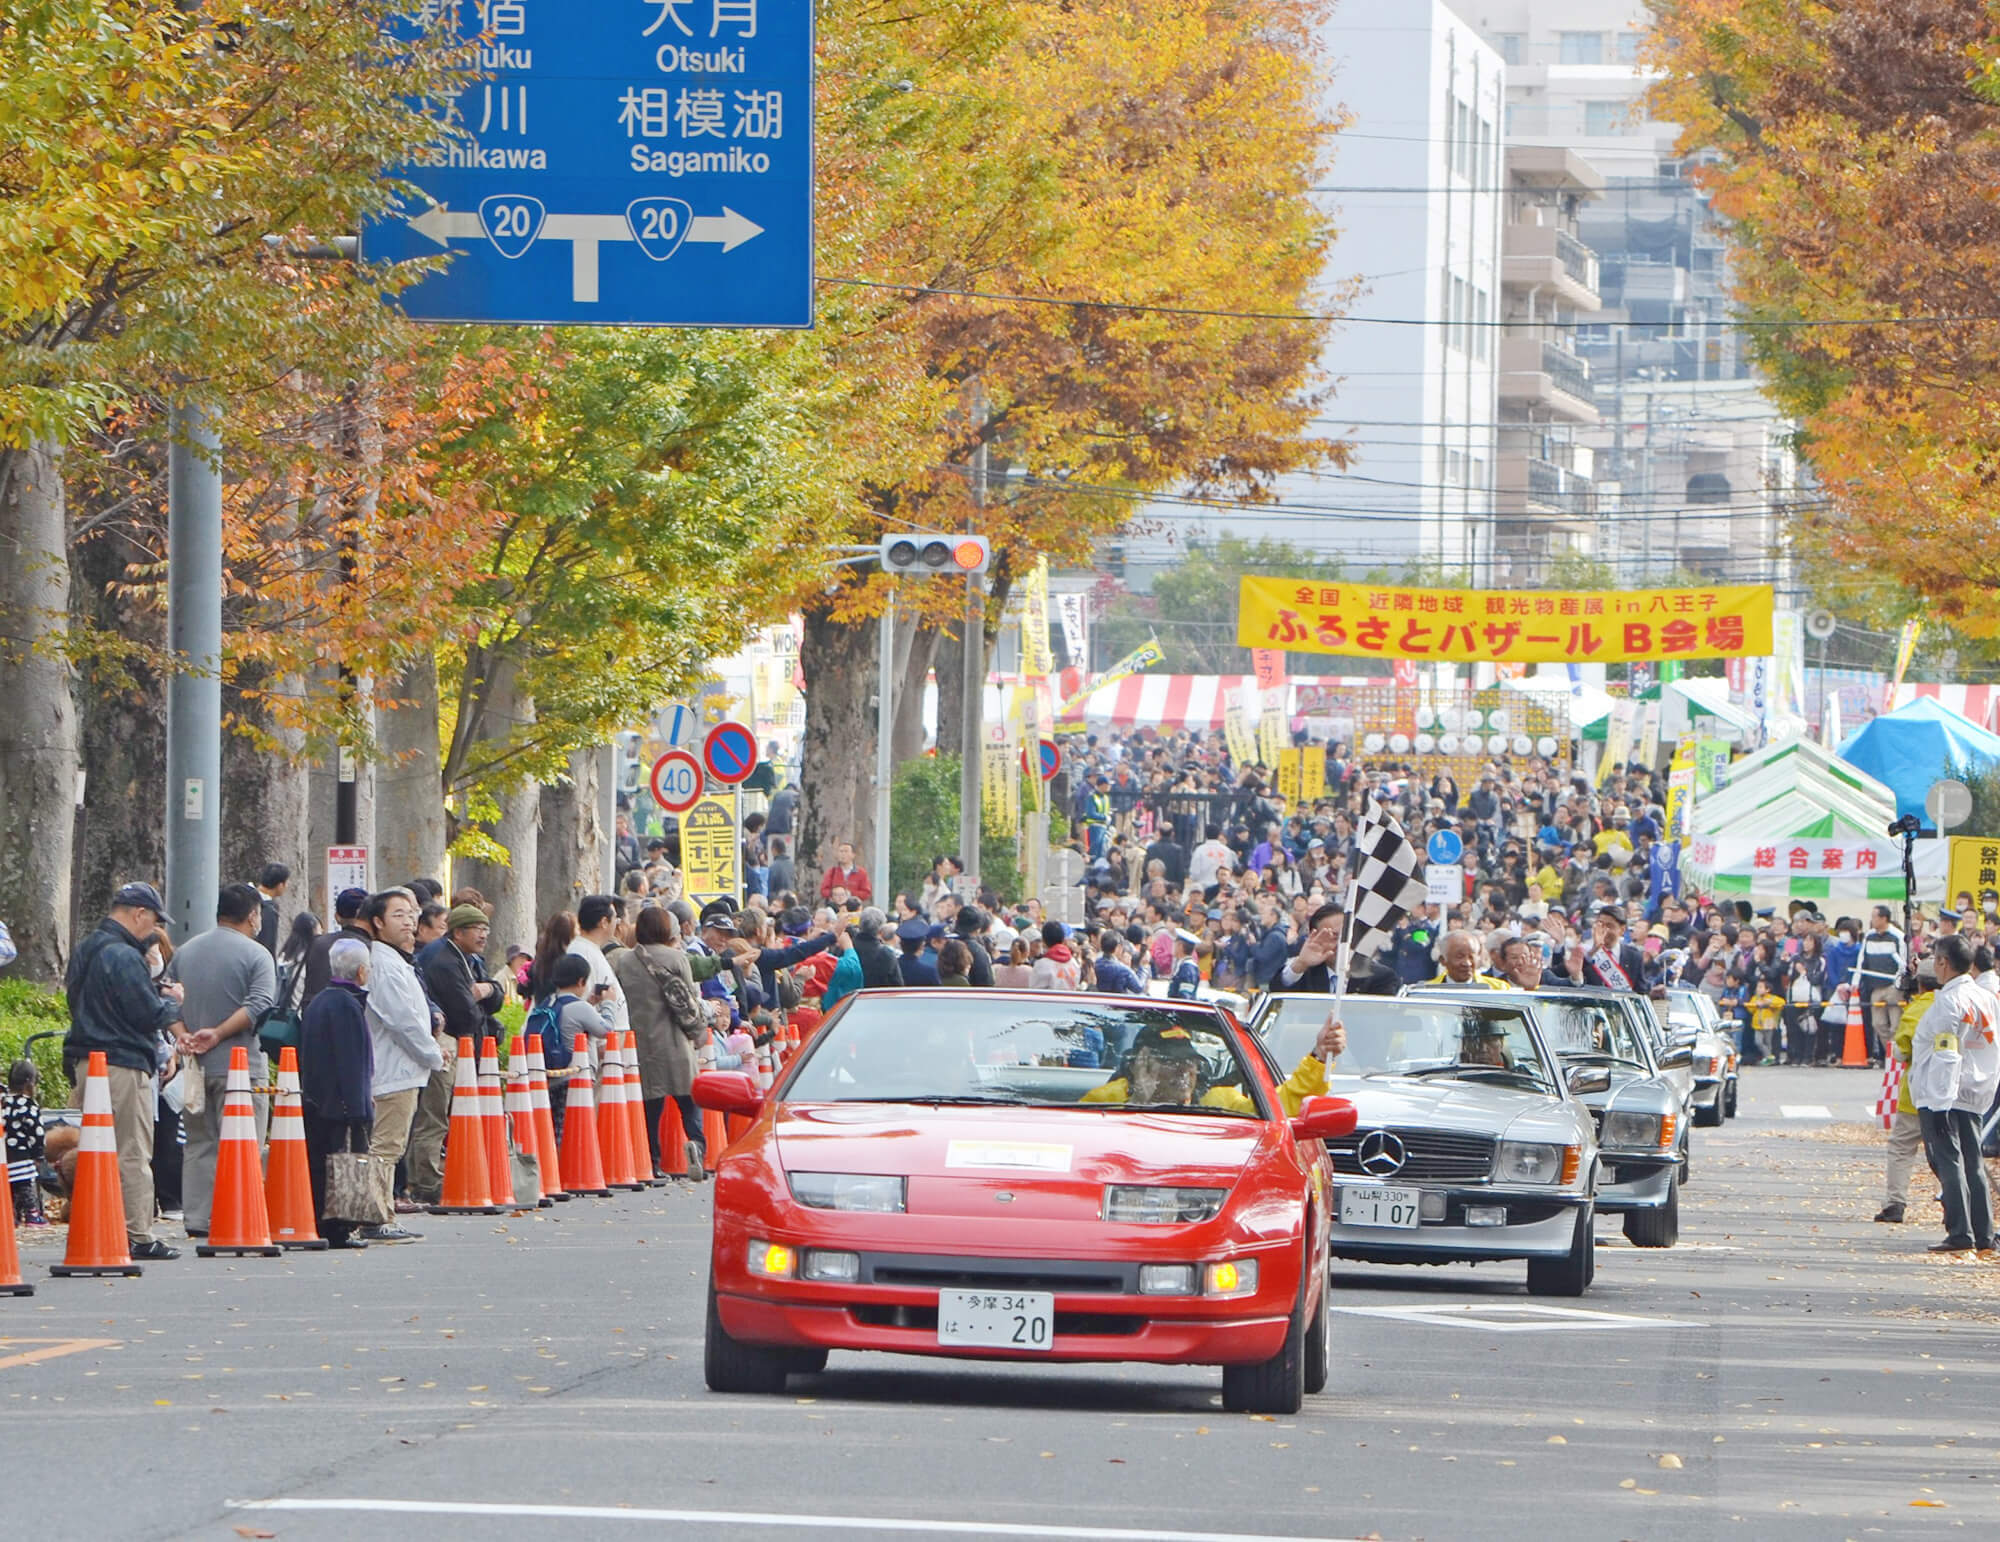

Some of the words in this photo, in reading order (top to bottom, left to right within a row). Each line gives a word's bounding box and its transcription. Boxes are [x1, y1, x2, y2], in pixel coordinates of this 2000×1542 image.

[656, 44, 745, 73] Otsuki
[618, 86, 782, 139] 相模湖
[631, 144, 770, 177] Sagamiko
[494, 205, 531, 237] 20
[641, 207, 678, 240] 20
[1649, 594, 1719, 614] 八王子
[1268, 609, 1603, 656] ふるさとバザール
[1624, 616, 1744, 654] B会場
[663, 768, 692, 794] 40
[1753, 847, 1877, 870] 総合案内
